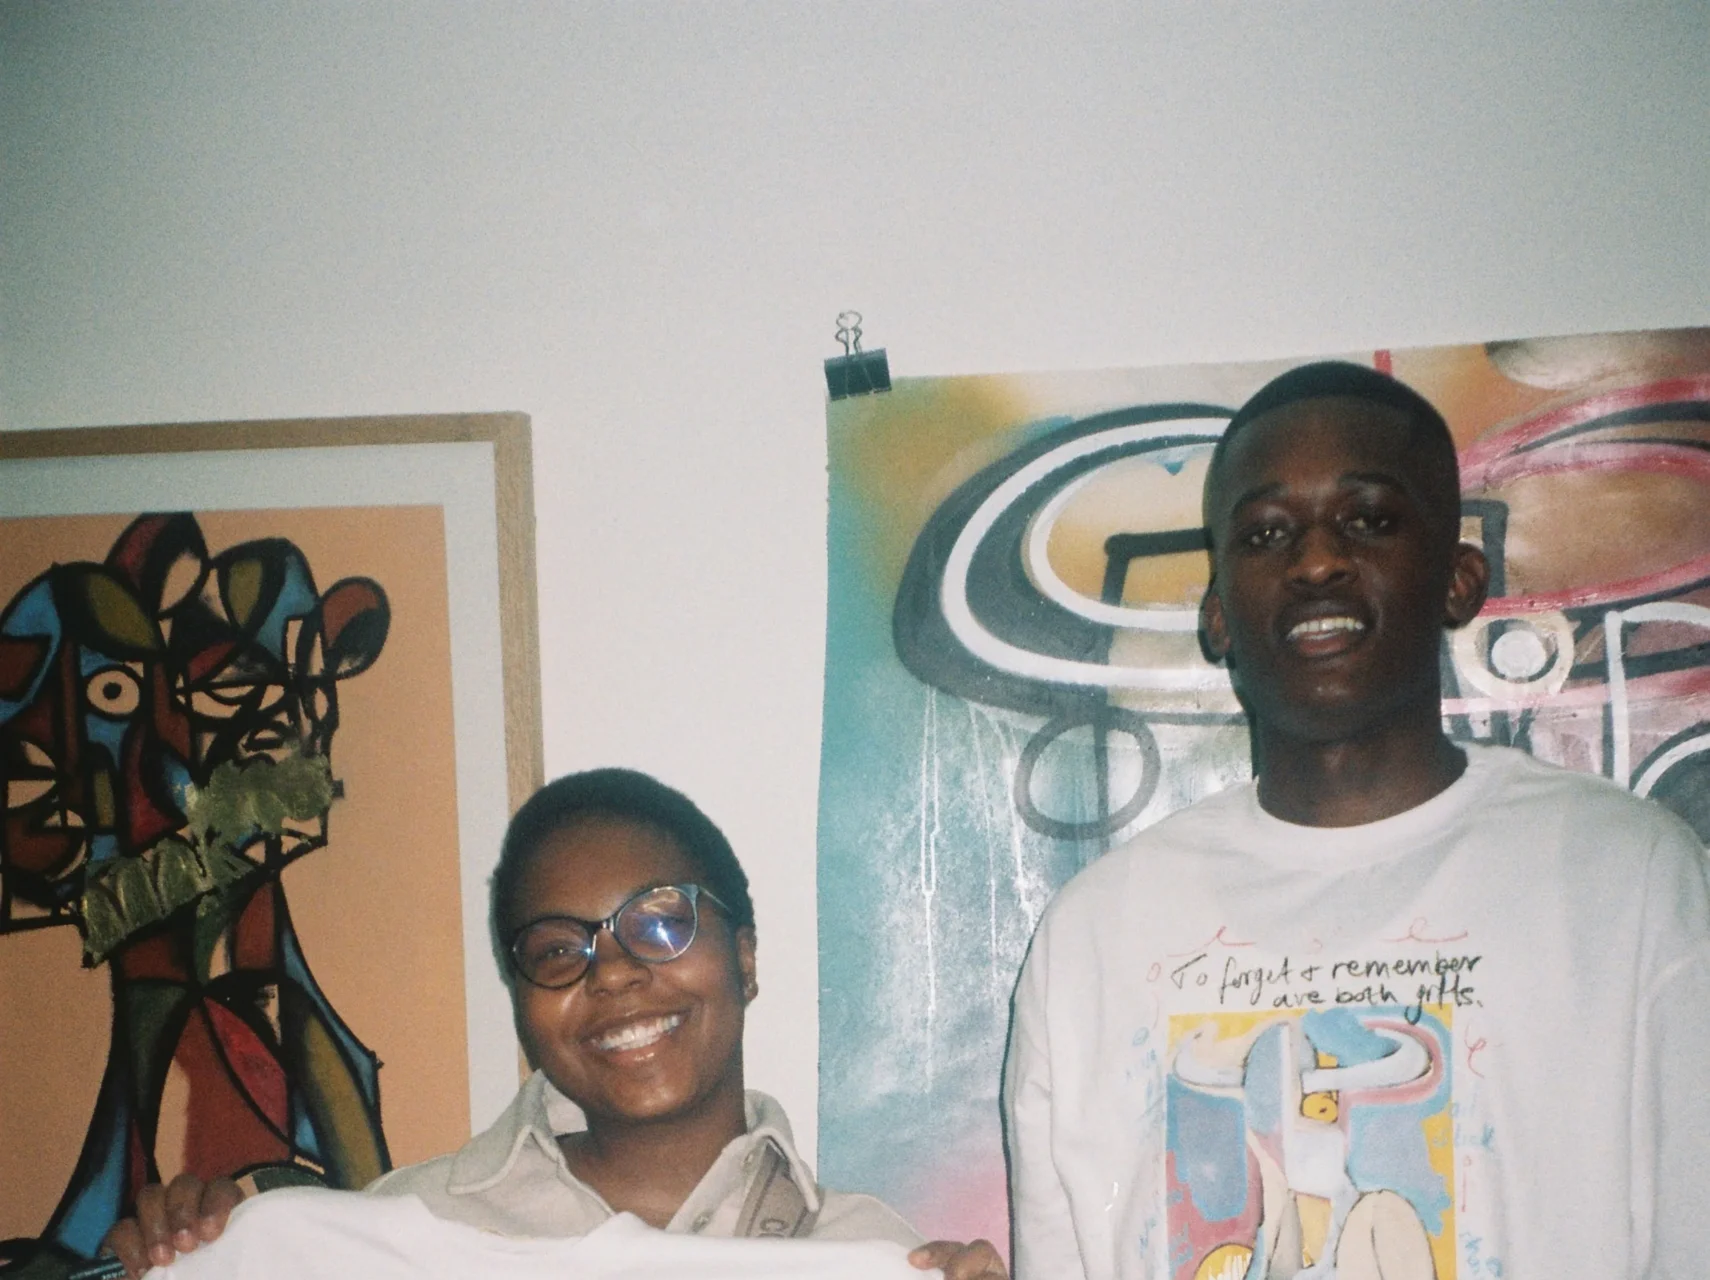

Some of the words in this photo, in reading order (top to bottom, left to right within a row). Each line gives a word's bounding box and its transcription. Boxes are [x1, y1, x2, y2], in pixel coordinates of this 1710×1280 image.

[1171, 953, 1208, 989] To
[1219, 956, 1289, 1005] forget
[1332, 949, 1483, 979] remember
[1273, 987, 1323, 1008] are
[1334, 981, 1398, 1004] both
